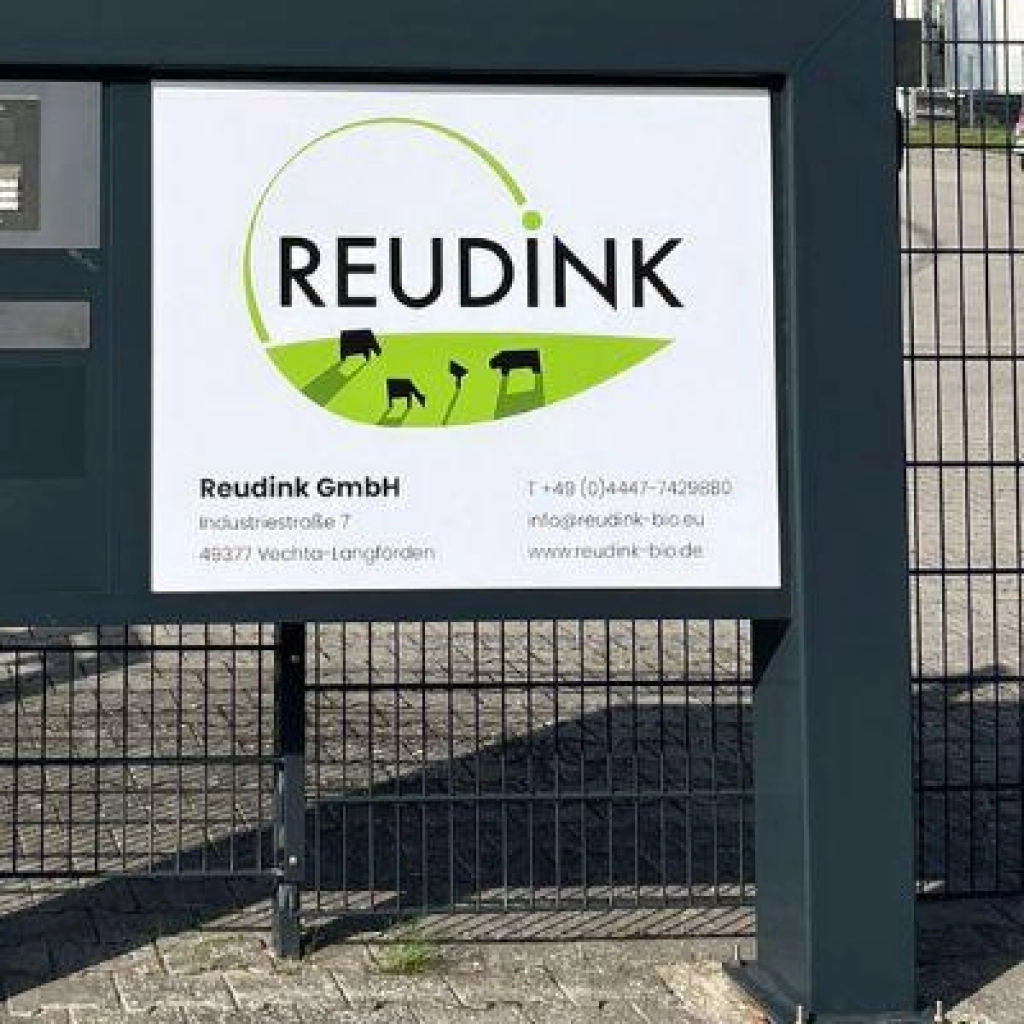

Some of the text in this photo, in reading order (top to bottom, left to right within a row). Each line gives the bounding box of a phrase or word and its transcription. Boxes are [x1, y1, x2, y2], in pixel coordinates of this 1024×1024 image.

[279, 234, 684, 311] REUDINK
[199, 476, 400, 498] Reudink GmbH
[543, 480, 576, 496] +49
[199, 512, 352, 531] Industriestraße 7
[528, 512, 705, 530] info@reudink-bio.eu
[200, 544, 436, 566] 49377 Vechta-Langförden
[528, 542, 703, 559] www.reudink-bio.de
